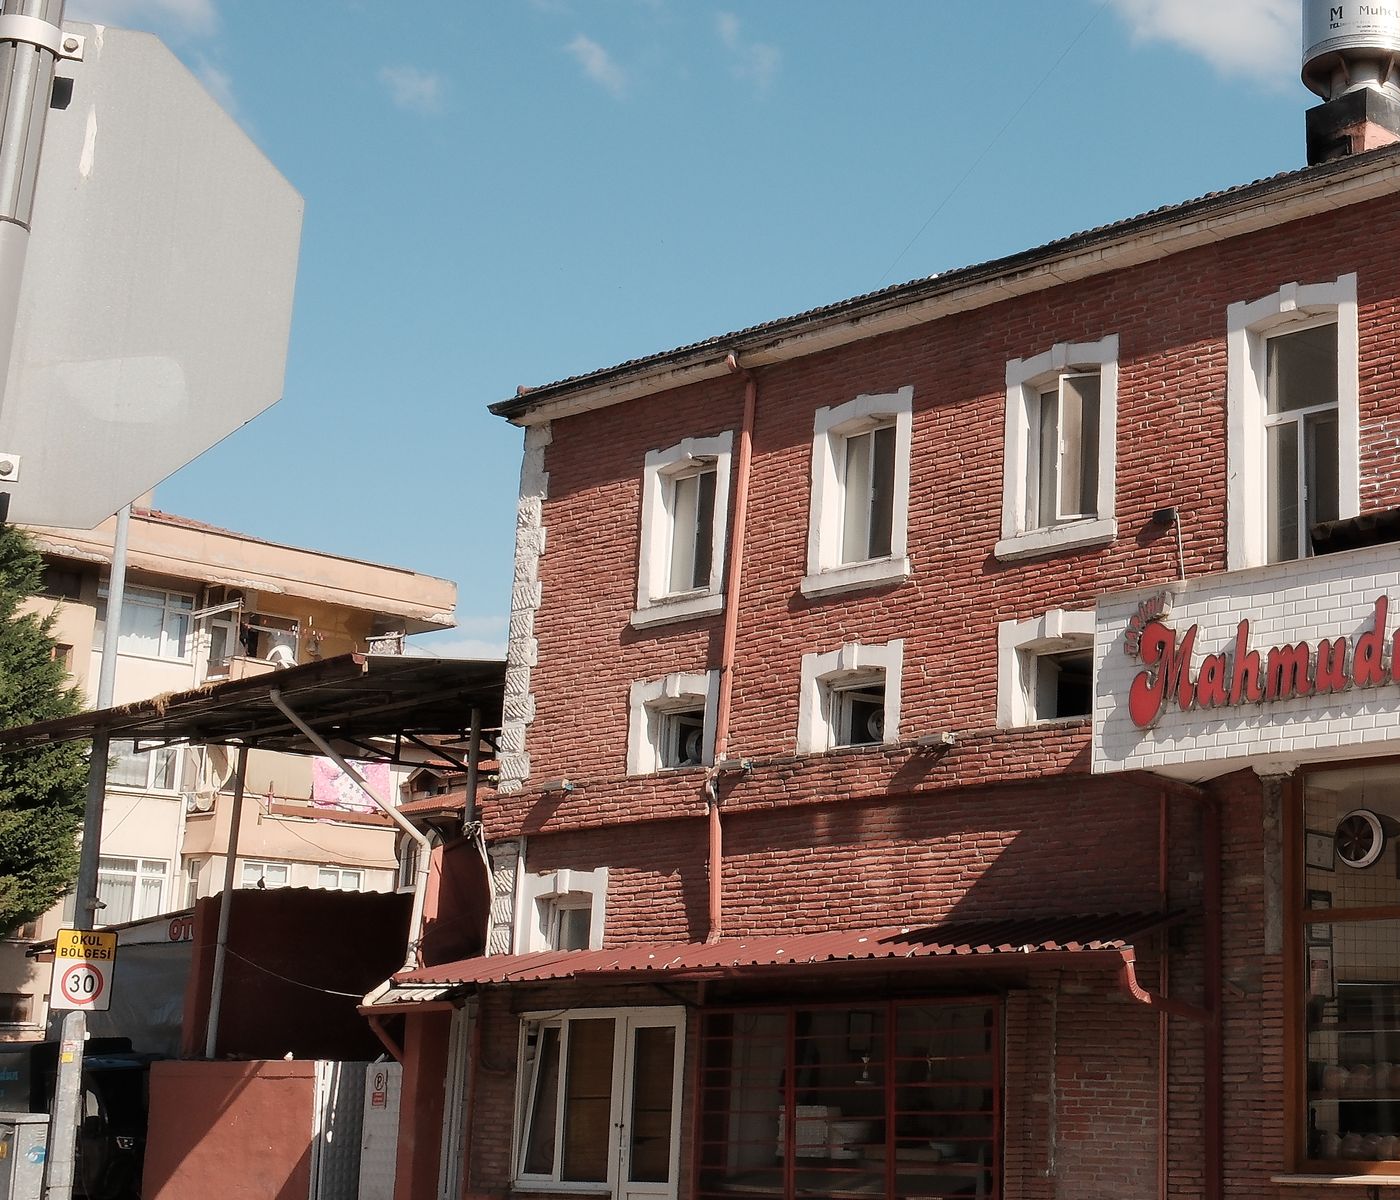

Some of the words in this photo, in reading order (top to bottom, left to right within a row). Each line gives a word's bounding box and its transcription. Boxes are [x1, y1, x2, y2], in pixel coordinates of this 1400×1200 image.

[71, 935, 103, 946] OKUL
[61, 945, 111, 959] BÖLGESİ
[69, 974, 95, 993] 30
